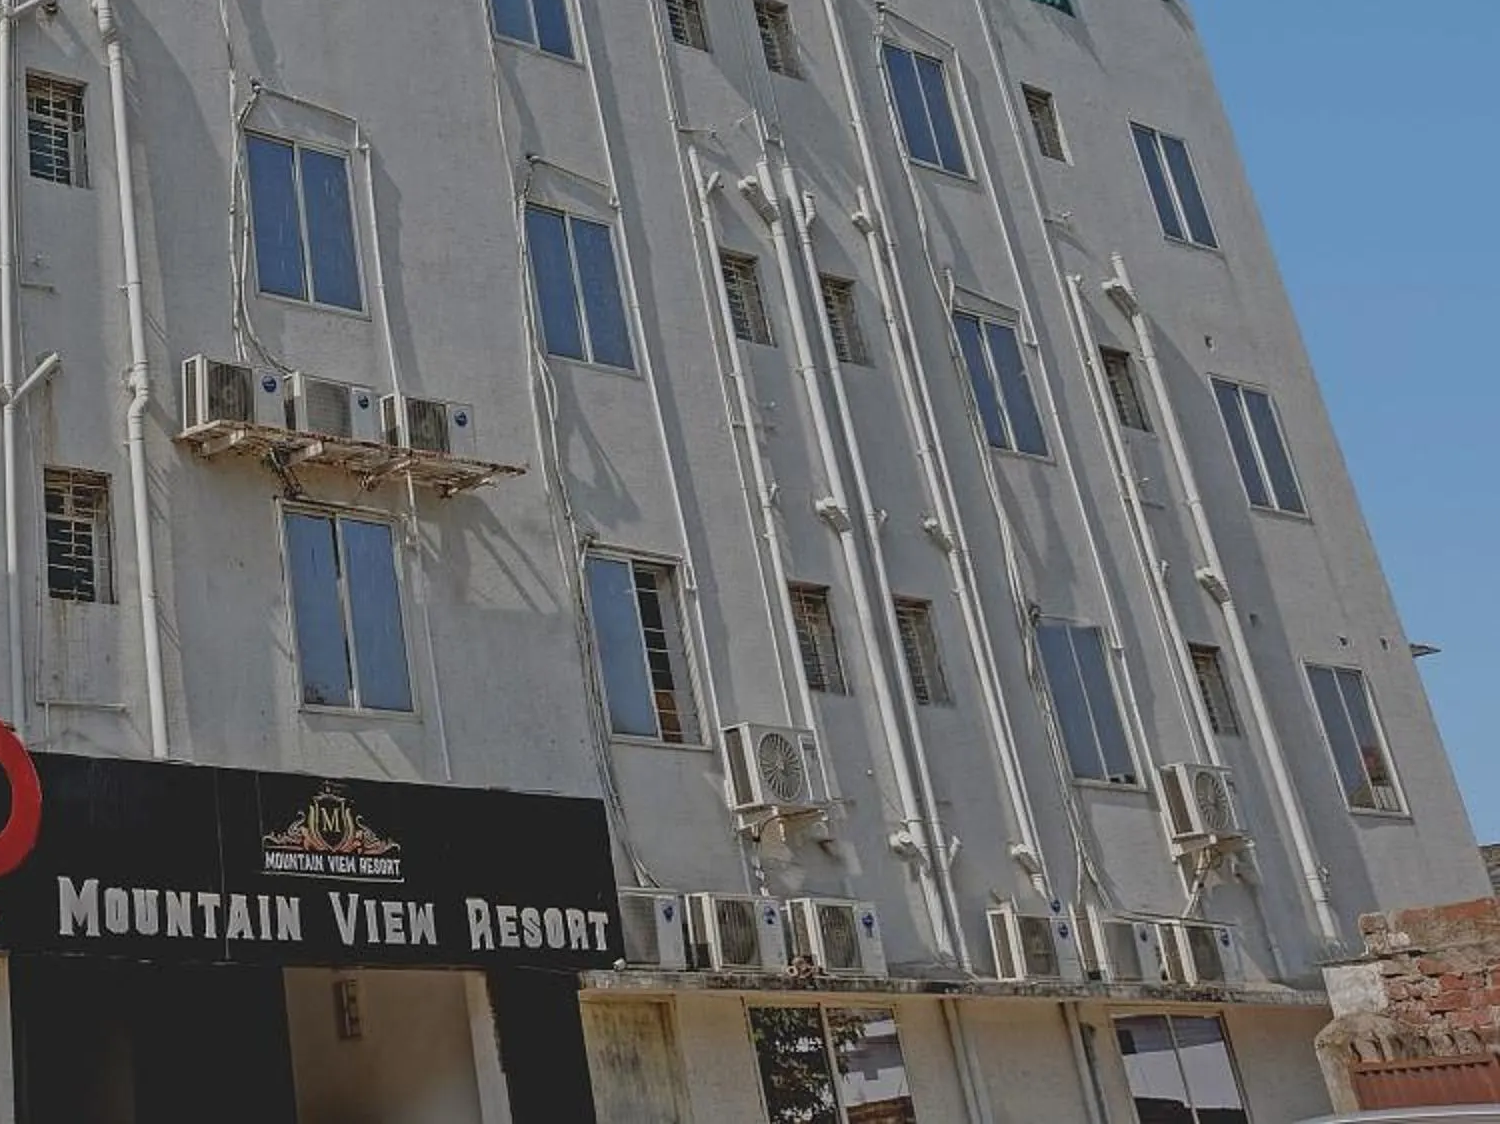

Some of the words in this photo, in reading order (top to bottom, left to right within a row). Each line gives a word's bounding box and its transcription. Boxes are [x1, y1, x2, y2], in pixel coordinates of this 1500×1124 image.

[320, 806, 341, 834] M
[264, 851, 325, 873] MOUNTAIN
[327, 854, 357, 874] VIEW
[359, 857, 401, 877] RESORT
[57, 876, 303, 941] MOUNTAIN
[327, 891, 438, 945] VIEW
[465, 897, 610, 951] RESORT
